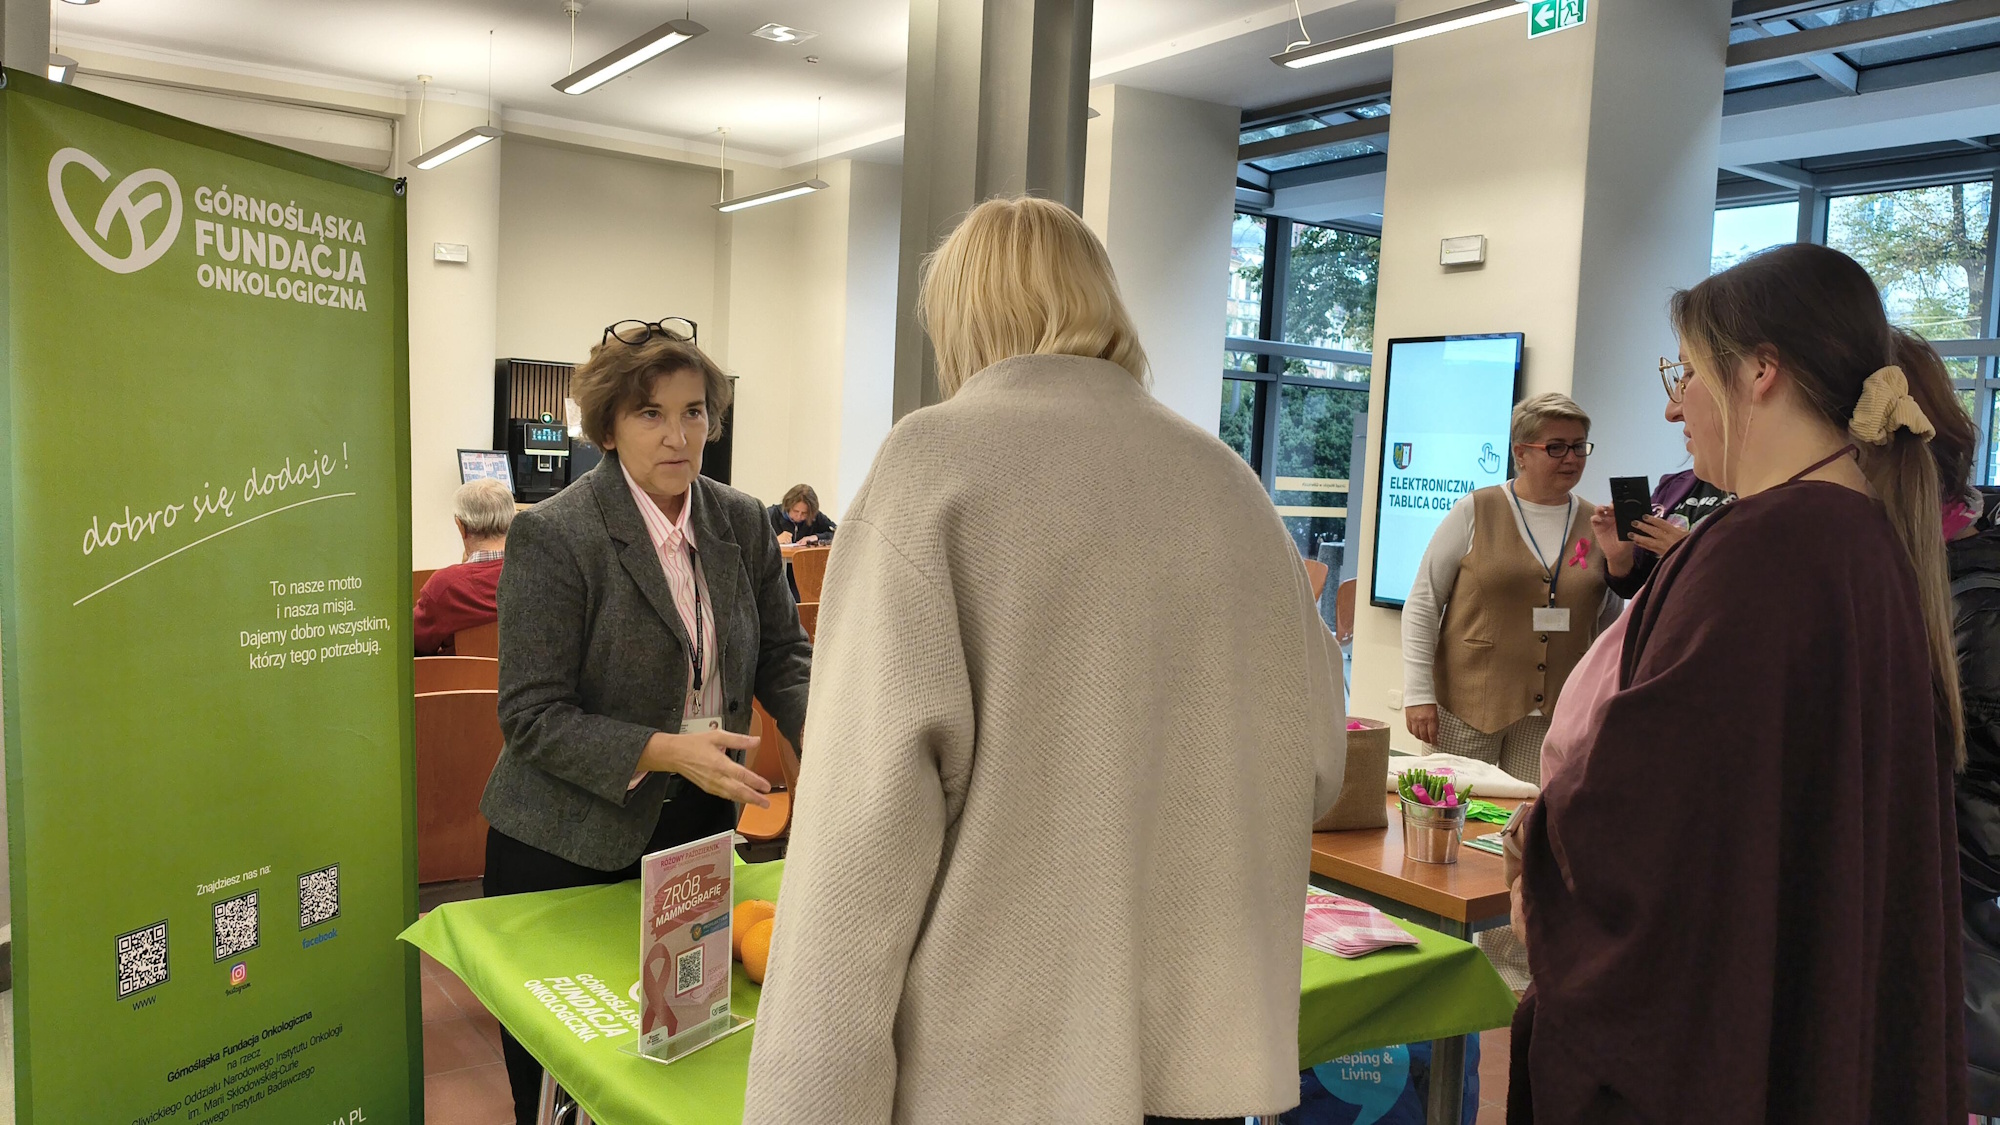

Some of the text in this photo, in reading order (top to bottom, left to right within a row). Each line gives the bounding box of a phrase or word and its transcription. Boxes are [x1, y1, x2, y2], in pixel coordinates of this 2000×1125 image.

[194, 184, 367, 245] GÓRNOŚLĄSKA
[194, 219, 367, 285] FUNDACJA
[197, 264, 368, 312] ONKOLOGICZNA
[82, 503, 184, 555] dobro
[193, 481, 236, 523] się
[244, 449, 337, 501] dodaje
[1389, 494, 1457, 511] TABLICA OGŁ
[1390, 476, 1475, 494] ELEKTRONICZNA
[270, 575, 362, 597] To nasze motto
[276, 597, 357, 619] i nasza misja.
[240, 615, 391, 651] Dajemy dobro wszystkim,
[249, 637, 382, 670] którzy tego potrzebują.
[196, 865, 272, 896] Znajdziesz nas na:
[662, 872, 701, 911] ZRÓB
[655, 883, 722, 928] MAMMOGRAFIĘ
[302, 928, 338, 949] facebook
[523, 979, 600, 1044] ONKOLOGICZNA
[543, 976, 629, 1038] FUNDACJA
[575, 973, 640, 1031] GÓRNOŚLĄSK
[167, 1010, 313, 1083] Górnośląska Fundacja Onkologiczna
[184, 1082, 221, 1106] Oddziału
[223, 1056, 274, 1088] Narodowego
[276, 1040, 308, 1063] Instytutu
[309, 1023, 343, 1047] Onkologii
[227, 1049, 262, 1071] na rzecz
[1325, 1052, 1394, 1067] eeping &
[203, 1093, 225, 1112] Marii
[226, 1059, 300, 1102] Skłodowskiej-Curie
[231, 1090, 265, 1114] Instytutu
[267, 1065, 316, 1096] Badawczego
[1341, 1068, 1381, 1084] Living
